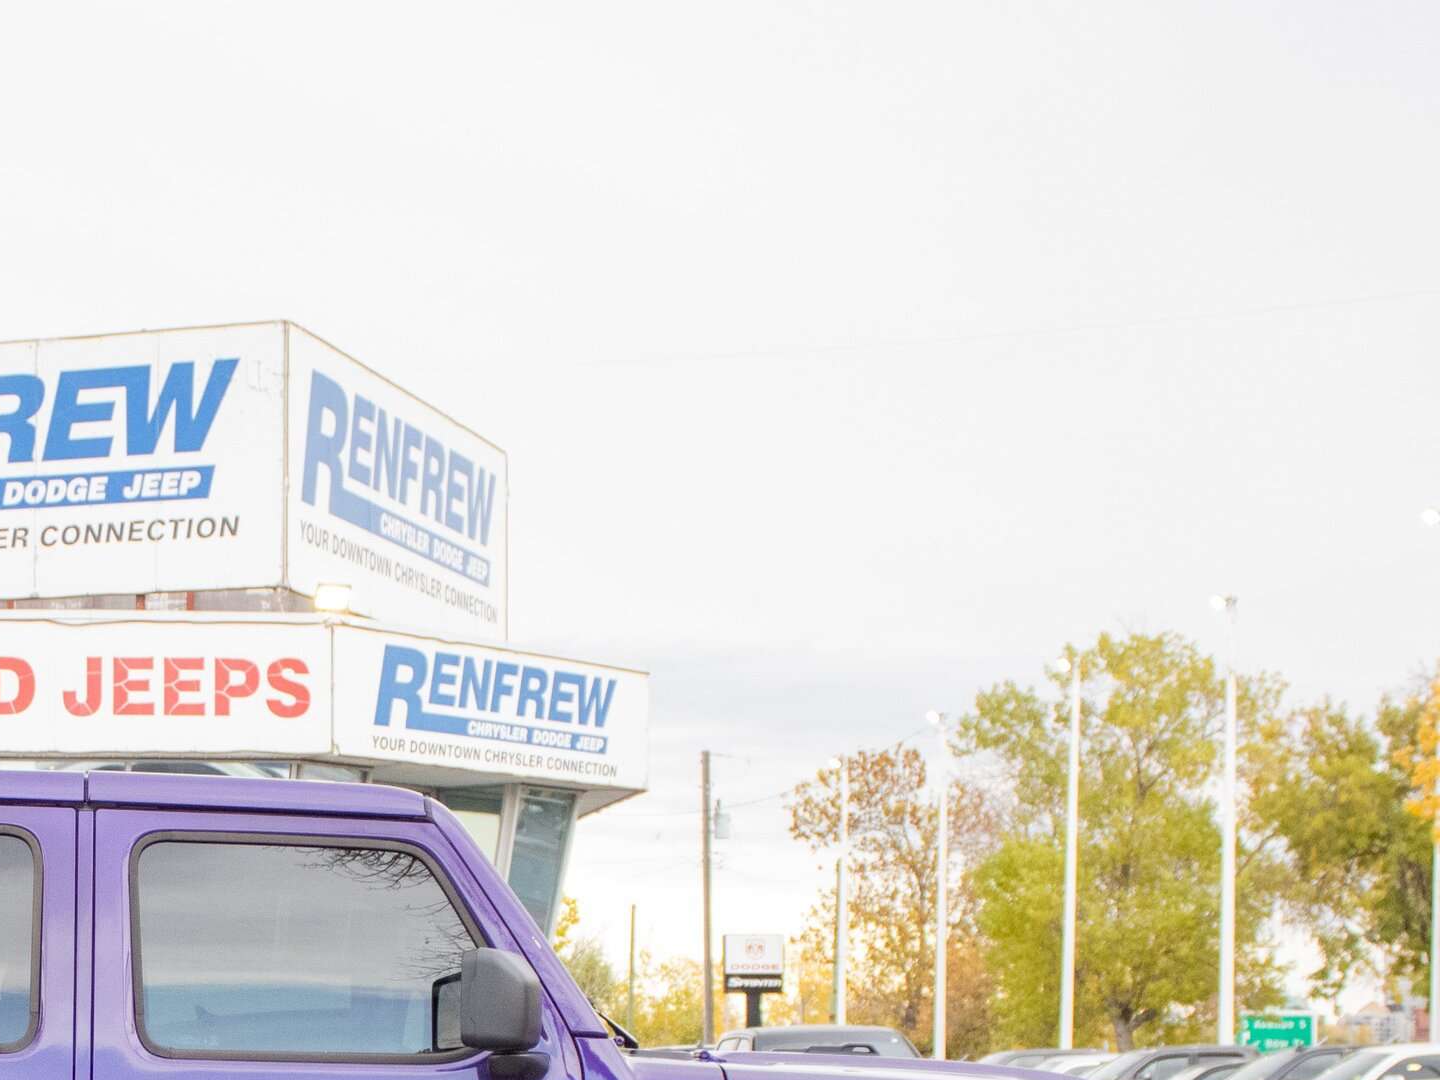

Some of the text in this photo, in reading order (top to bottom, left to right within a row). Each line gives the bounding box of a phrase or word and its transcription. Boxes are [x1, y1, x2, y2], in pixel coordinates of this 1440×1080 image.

[3, 475, 110, 506] DODGE
[123, 470, 202, 499] JEEP
[301, 368, 496, 547] RENFREW
[41, 515, 240, 547] CONNECTION
[380, 512, 488, 582] CHRYSLER DODGE JEEP
[300, 520, 498, 624] YOUR DOWNTOWN CHRYSLER CONNECTION
[62, 655, 312, 719] JEEPS
[373, 643, 617, 728] RENFREW
[372, 736, 618, 778] YOUR DOWNTOWN CHRYSLER CONNECTION
[467, 721, 605, 751] CHRYSLER DODGE JEEP
